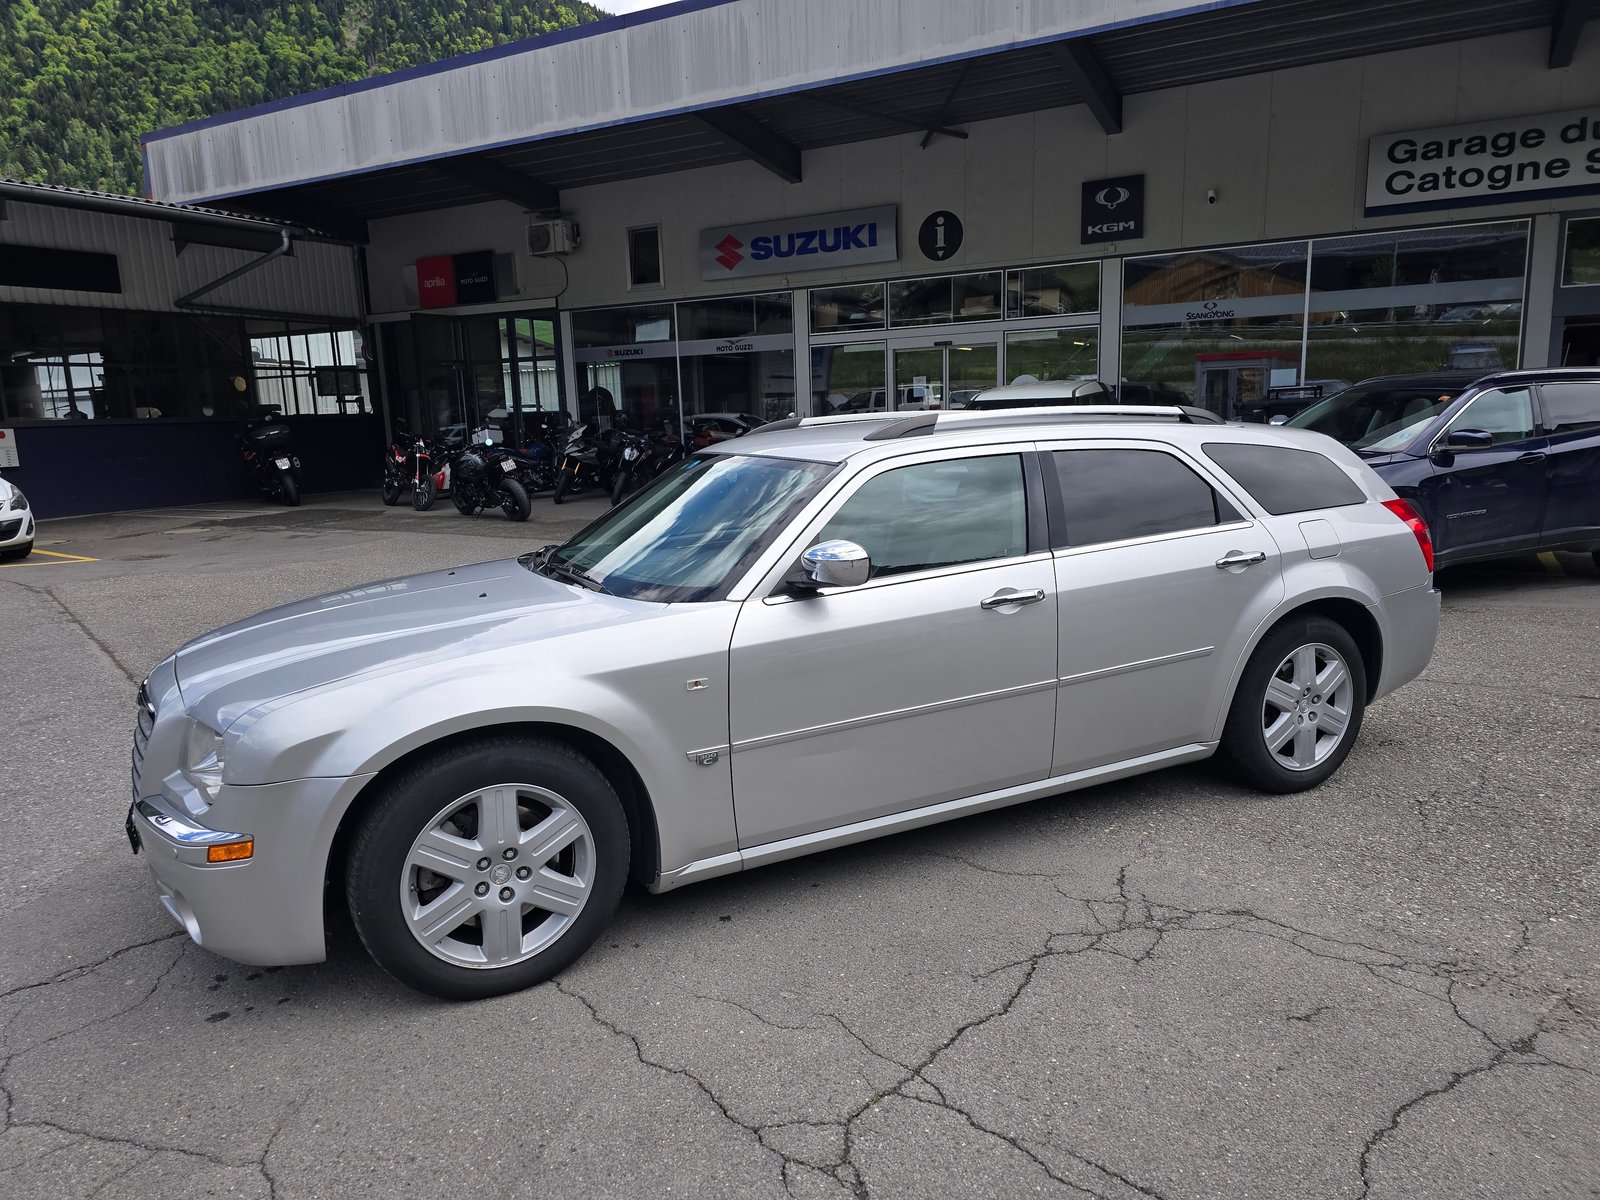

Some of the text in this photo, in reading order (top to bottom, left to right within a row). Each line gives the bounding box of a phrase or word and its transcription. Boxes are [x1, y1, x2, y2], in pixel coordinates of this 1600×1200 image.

[1387, 128, 1546, 164] Garage
[1385, 157, 1571, 196] Catogne
[1087, 220, 1135, 235] KGM
[750, 222, 877, 261] SUZUKI
[424, 277, 446, 288] aprilia
[614, 348, 643, 357] SUZUKI
